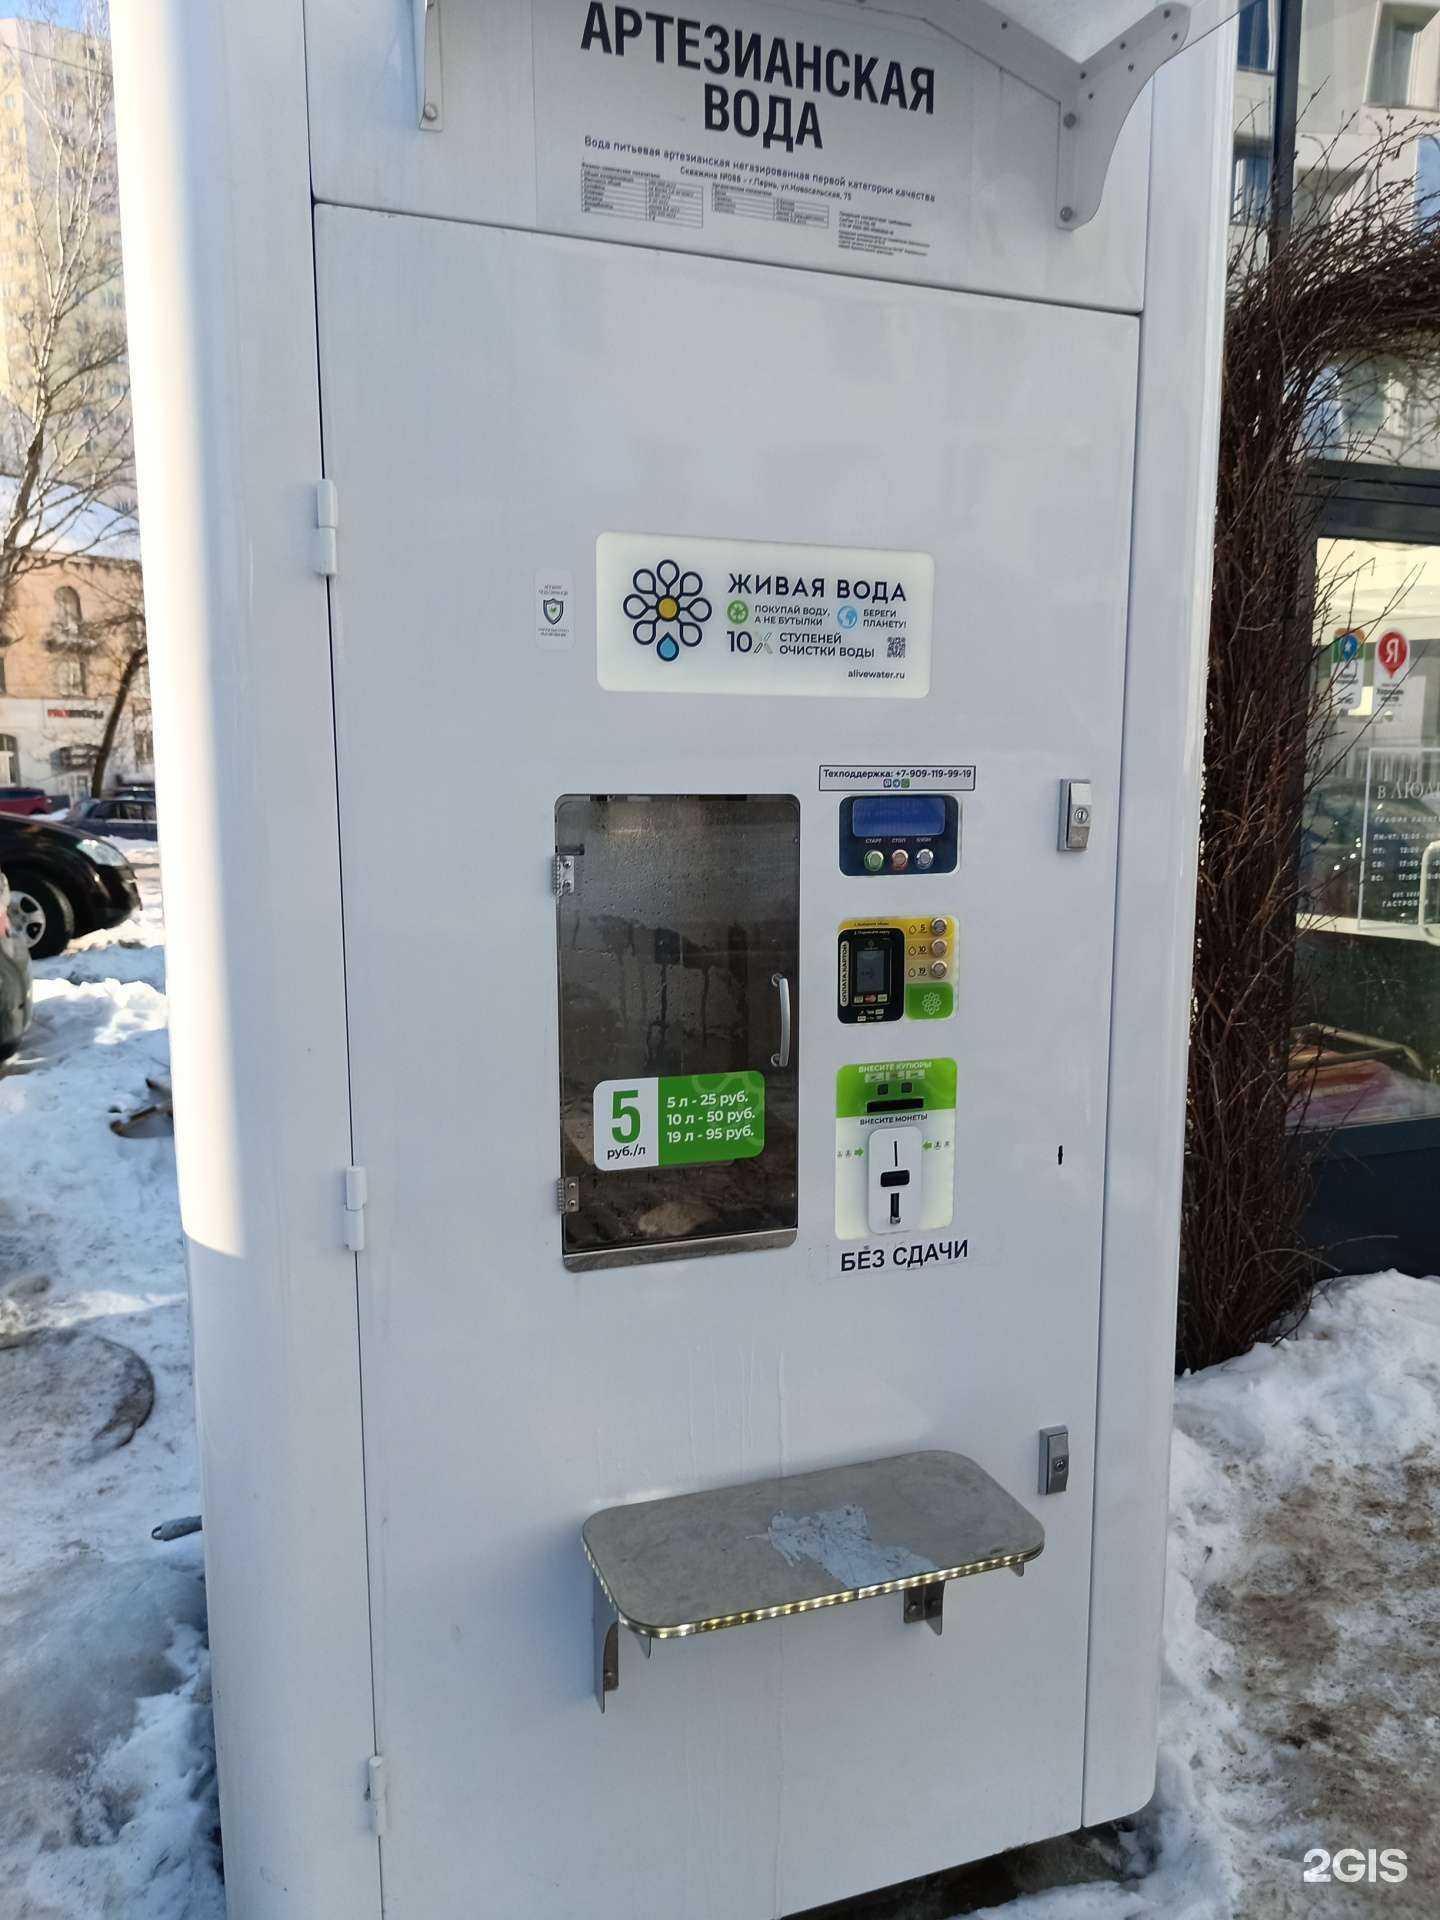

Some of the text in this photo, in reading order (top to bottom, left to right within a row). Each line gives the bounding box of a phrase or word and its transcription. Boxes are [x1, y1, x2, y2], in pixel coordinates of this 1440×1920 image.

[580, 1, 935, 115] АРТЕЗИАНСКАЯ
[704, 83, 823, 153] ВОДА
[584, 135, 935, 202] Вода питьевая артезианская негазированная первой категории качества
[727, 573, 907, 604] ЖИВАЯ ВОДА
[754, 604, 831, 617] ПОКУПАЙ ВОДУ,
[863, 609, 897, 618] БЕРЕГИ
[754, 616, 823, 626] А НЕ БУТЫЛКИ
[863, 619, 907, 629] ПЛАНЕТУ!
[779, 632, 842, 644] СТУПЕНЕЙ
[779, 646, 875, 659] ОЧИСТКИ ВОДЫ
[847, 670, 905, 679] alivewater.ru
[823, 769, 972, 779] Техподдержка: +7-909-119-99-19
[858, 1061, 932, 1073] ВНЕСИТЕ КУПЮРЫ
[667, 1097, 676, 1108] 5
[678, 1098, 688, 1107] л
[700, 1093, 717, 1106] 25
[720, 1091, 748, 1107] руб.
[611, 1089, 641, 1143] 5
[667, 1114, 682, 1126] 10
[685, 1115, 694, 1124] л
[706, 1111, 723, 1123] 50
[727, 1107, 756, 1123] руб.
[860, 1113, 928, 1126] ВНЕСИТЕ МОНЕТЫ
[667, 1131, 681, 1143] 19
[684, 1132, 694, 1142] л
[706, 1128, 723, 1140] 95
[726, 1125, 754, 1141] руб.
[607, 1144, 646, 1160] руб./л
[840, 1239, 969, 1272] БЕЗ СДАЧИ
